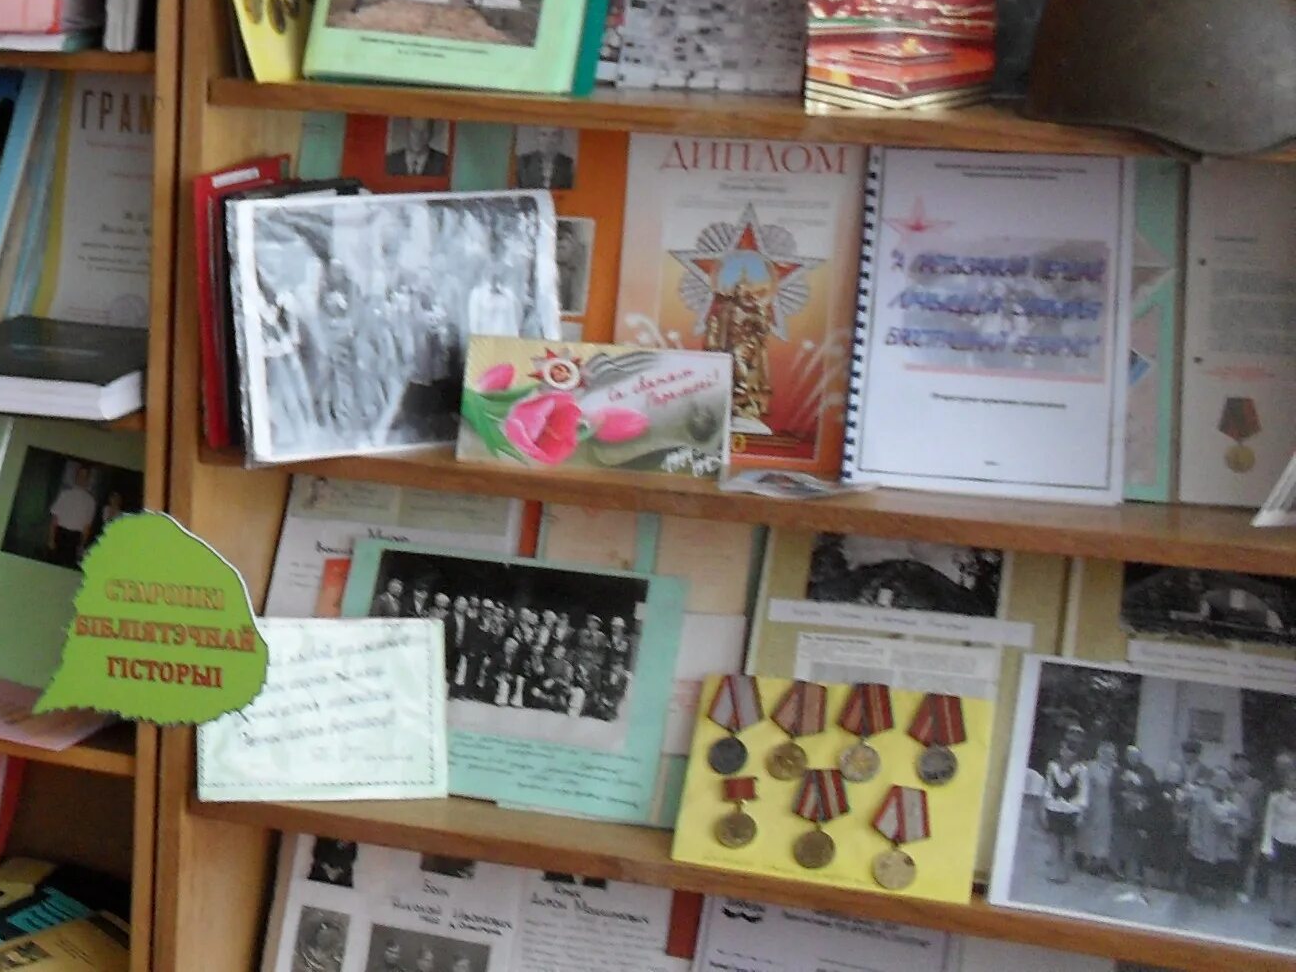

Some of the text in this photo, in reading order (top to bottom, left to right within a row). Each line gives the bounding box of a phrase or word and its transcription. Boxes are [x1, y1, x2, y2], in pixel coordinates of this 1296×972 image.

[660, 139, 848, 175] ДИПЛОМ
[74, 613, 256, 653] БІБЛІЯТЭЧНАЙ
[106, 655, 223, 689] ГІСТОРЫІ
